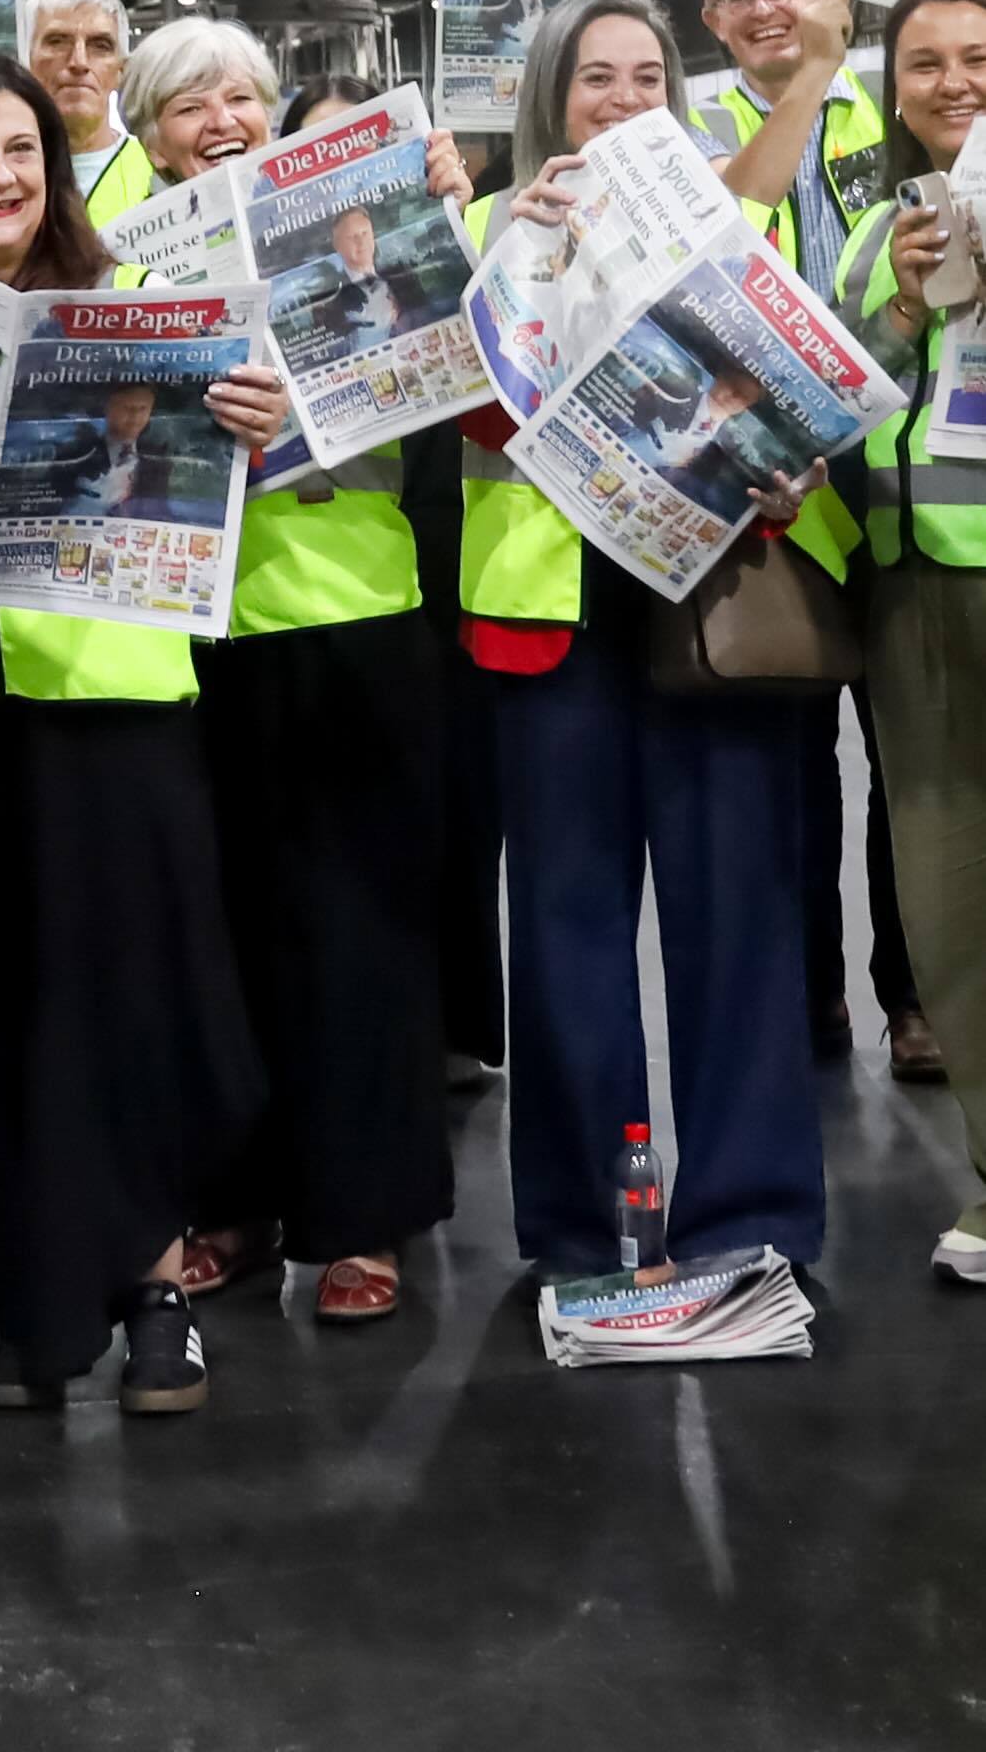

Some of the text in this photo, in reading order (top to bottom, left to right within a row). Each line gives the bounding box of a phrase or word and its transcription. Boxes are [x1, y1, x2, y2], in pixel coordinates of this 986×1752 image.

[276, 123, 380, 179] Die Papier
[276, 190, 311, 214] DG:
[375, 156, 398, 172] en
[588, 149, 654, 241] min speelkans
[609, 135, 681, 238] Vrae oor Jurie se
[658, 152, 703, 209] Sport
[115, 208, 176, 250] Sport
[182, 233, 200, 248] se
[263, 203, 328, 247] politici
[331, 185, 385, 215] meng
[72, 304, 208, 336] Die Papier
[750, 270, 851, 379] Die Papier
[28, 366, 112, 389] politici
[119, 367, 184, 386] meng
[56, 344, 100, 363] DG:
[186, 348, 214, 362] en
[679, 292, 750, 359] politici
[743, 357, 792, 411] meng
[716, 290, 751, 331] DG:
[804, 385, 829, 411] en
[309, 383, 366, 413] NAWEEK-
[313, 392, 371, 425] WENNERS
